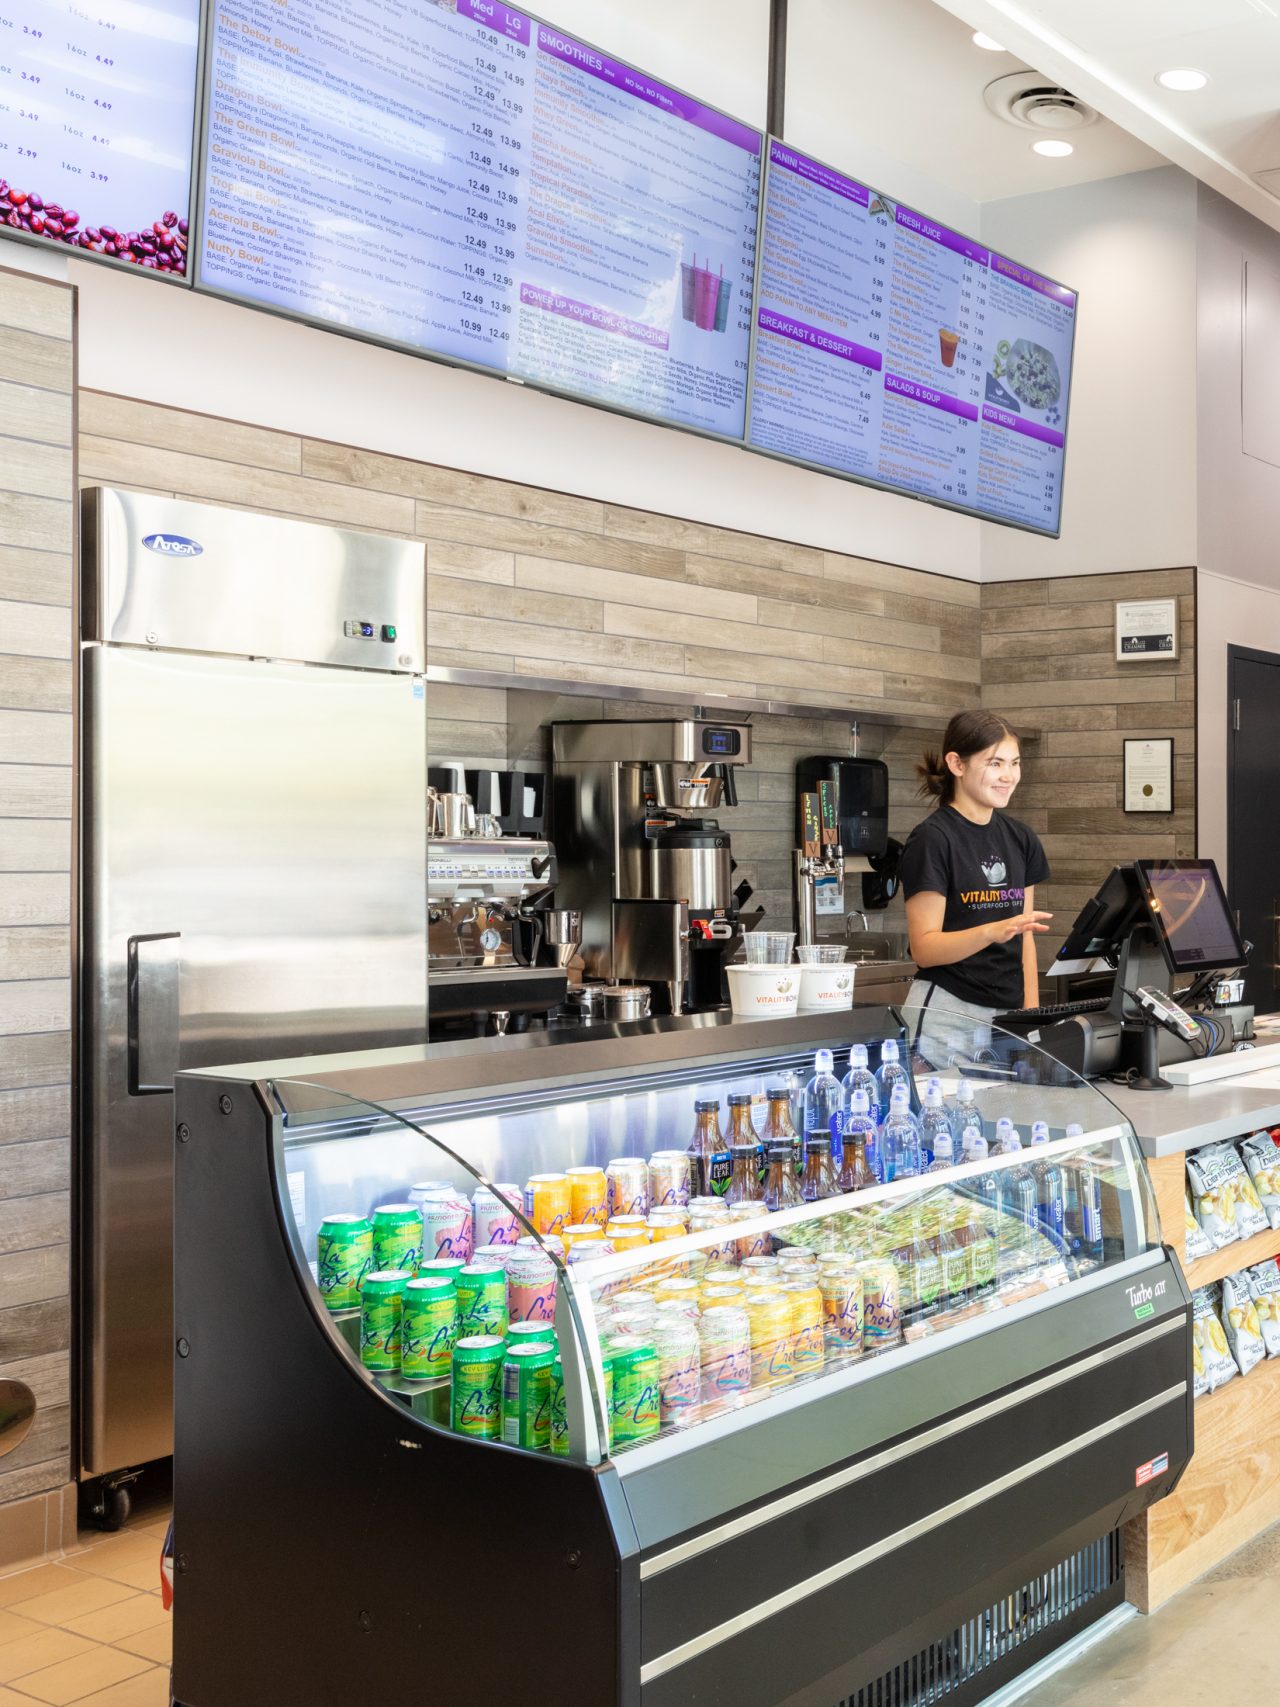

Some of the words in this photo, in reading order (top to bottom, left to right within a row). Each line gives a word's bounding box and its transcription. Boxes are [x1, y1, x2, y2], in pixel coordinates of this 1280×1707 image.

[470, 0, 493, 17] Med
[505, 12, 521, 30] LG
[22, 26, 43, 39] 3.49
[220, 14, 238, 31] The
[241, 23, 270, 45] Detox
[274, 37, 299, 57] Bowl
[476, 28, 497, 46] 10.49
[505, 42, 525, 59] 11.99
[66, 42, 88, 57] 16oz
[95, 55, 114, 67] 4.49
[539, 30, 602, 71] SMOOTHIES
[474, 56, 496, 74] 13.49
[503, 69, 524, 87] 14.99
[21, 71, 41, 84] 3.49
[64, 88, 86, 102] 16oz
[93, 99, 112, 111] 4.49
[216, 78, 253, 101] Dragon
[257, 94, 281, 113] Bowl
[473, 84, 494, 102] 12.49
[502, 97, 522, 114] 13.99
[625, 77, 634, 87] NO
[646, 87, 654, 97] NO
[215, 111, 233, 126] The
[236, 119, 266, 139] Green
[270, 132, 294, 149] Bowl
[471, 121, 492, 138] 12.49
[500, 134, 520, 150] 13.99
[18, 147, 38, 159] 2.99
[61, 161, 82, 175] 16oz
[90, 171, 109, 183] 3.99
[212, 142, 255, 167] Graviola
[258, 159, 283, 177] Bowl
[469, 150, 491, 166] 13.49
[498, 162, 519, 177] 14.99
[771, 147, 797, 168] PANINI
[467, 178, 489, 194] 12.49
[497, 189, 517, 204] 13.99
[209, 207, 248, 229] Acerola
[251, 221, 277, 238] Bowl
[466, 206, 488, 221] 12.49
[495, 217, 516, 232] 13.99
[527, 223, 557, 242] Graviola
[876, 216, 887, 227] 6.99
[897, 211, 920, 230] FRESH
[921, 223, 941, 240] JUICE
[207, 239, 234, 257] Nutty
[238, 249, 263, 265] Bowl
[464, 234, 486, 249] 12.49
[494, 244, 514, 259] 13.99
[463, 262, 485, 277] 11.49
[492, 272, 513, 286] 12.99
[461, 290, 483, 305] 12.49
[490, 300, 511, 314] 13.99
[870, 308, 880, 318] 4.99
[460, 318, 482, 332] 10.99
[489, 327, 510, 341] 12.49
[523, 288, 552, 306] POWER
[555, 299, 565, 310] UP
[568, 303, 590, 318] YOUR
[592, 311, 614, 326] BOWL
[629, 324, 667, 344] SMOOTHIE
[817, 311, 833, 322] MENU
[868, 331, 879, 340] 4.99
[760, 313, 808, 340] BREAKFAST
[809, 332, 815, 343] &
[817, 335, 852, 356] DESSERT
[860, 391, 870, 400] 6.49
[887, 377, 914, 394] SALADS
[915, 387, 920, 397] &
[922, 390, 940, 404] SOUP
[858, 414, 869, 423] 7.49
[983, 407, 997, 419] KIDS
[998, 412, 1015, 426] MENU
[808, 843, 818, 855] V
[826, 830, 835, 841] V
[714, 1164, 730, 1172] PURE
[714, 1170, 730, 1178] LEAF
[320, 1240, 342, 1271] La
[466, 1291, 490, 1321] La
[1125, 1283, 1152, 1307] Turbo
[1155, 1280, 1166, 1296] air
